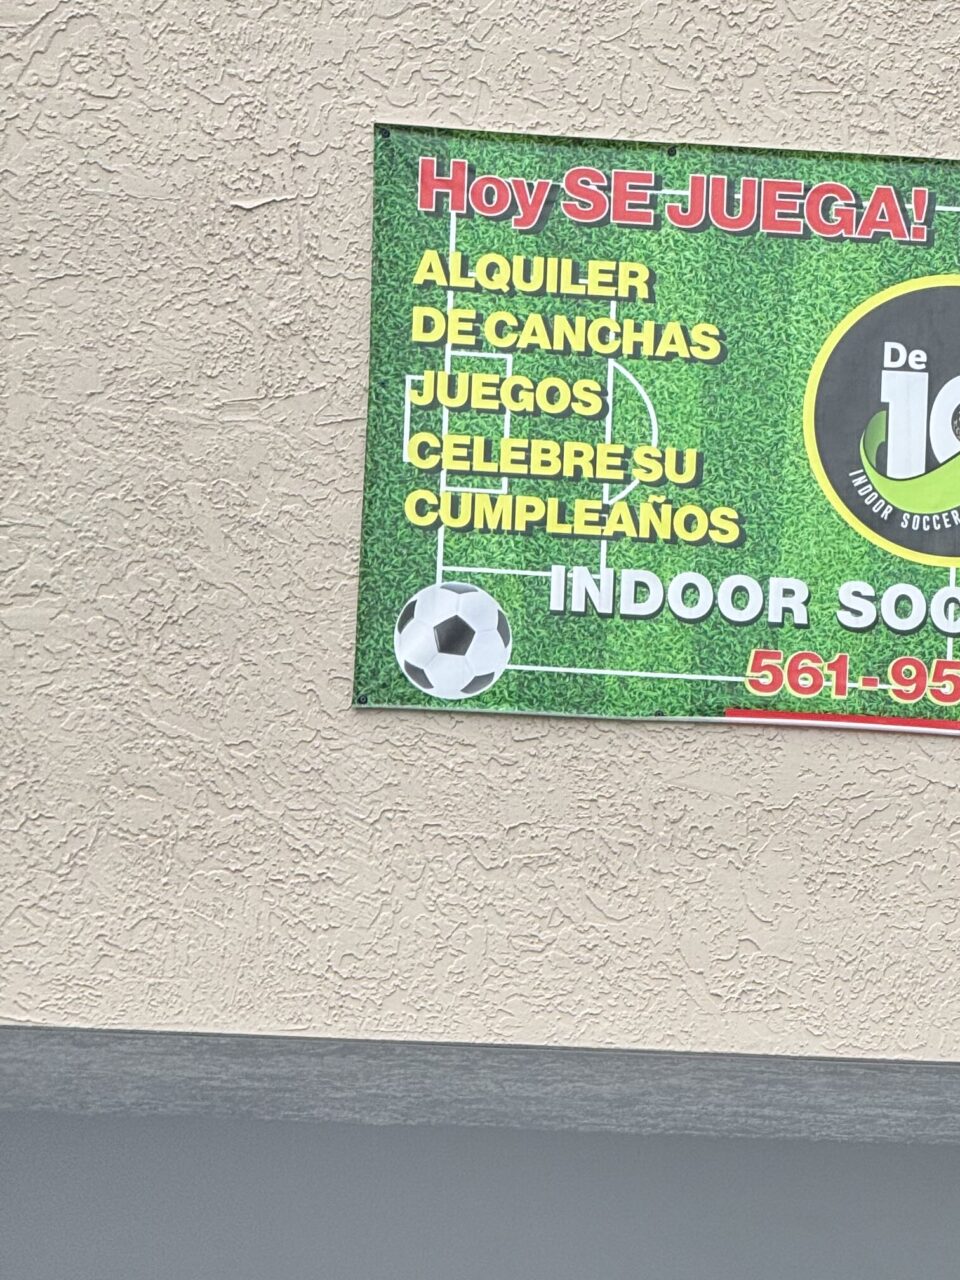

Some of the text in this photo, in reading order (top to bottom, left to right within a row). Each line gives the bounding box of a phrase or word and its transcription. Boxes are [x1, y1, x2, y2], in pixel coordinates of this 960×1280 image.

[417, 156, 930, 242] Hoy SE JUEGA!
[412, 249, 653, 300] ALQUILER
[411, 308, 723, 361] DE CANCHAS
[883, 341, 928, 370] De
[407, 370, 604, 417] JUEGOS
[406, 430, 699, 485] CELEBRE SU
[403, 490, 742, 545] CUMPLEAÑOS
[848, 469, 894, 521] INDOOR
[549, 564, 809, 627] INDOOR
